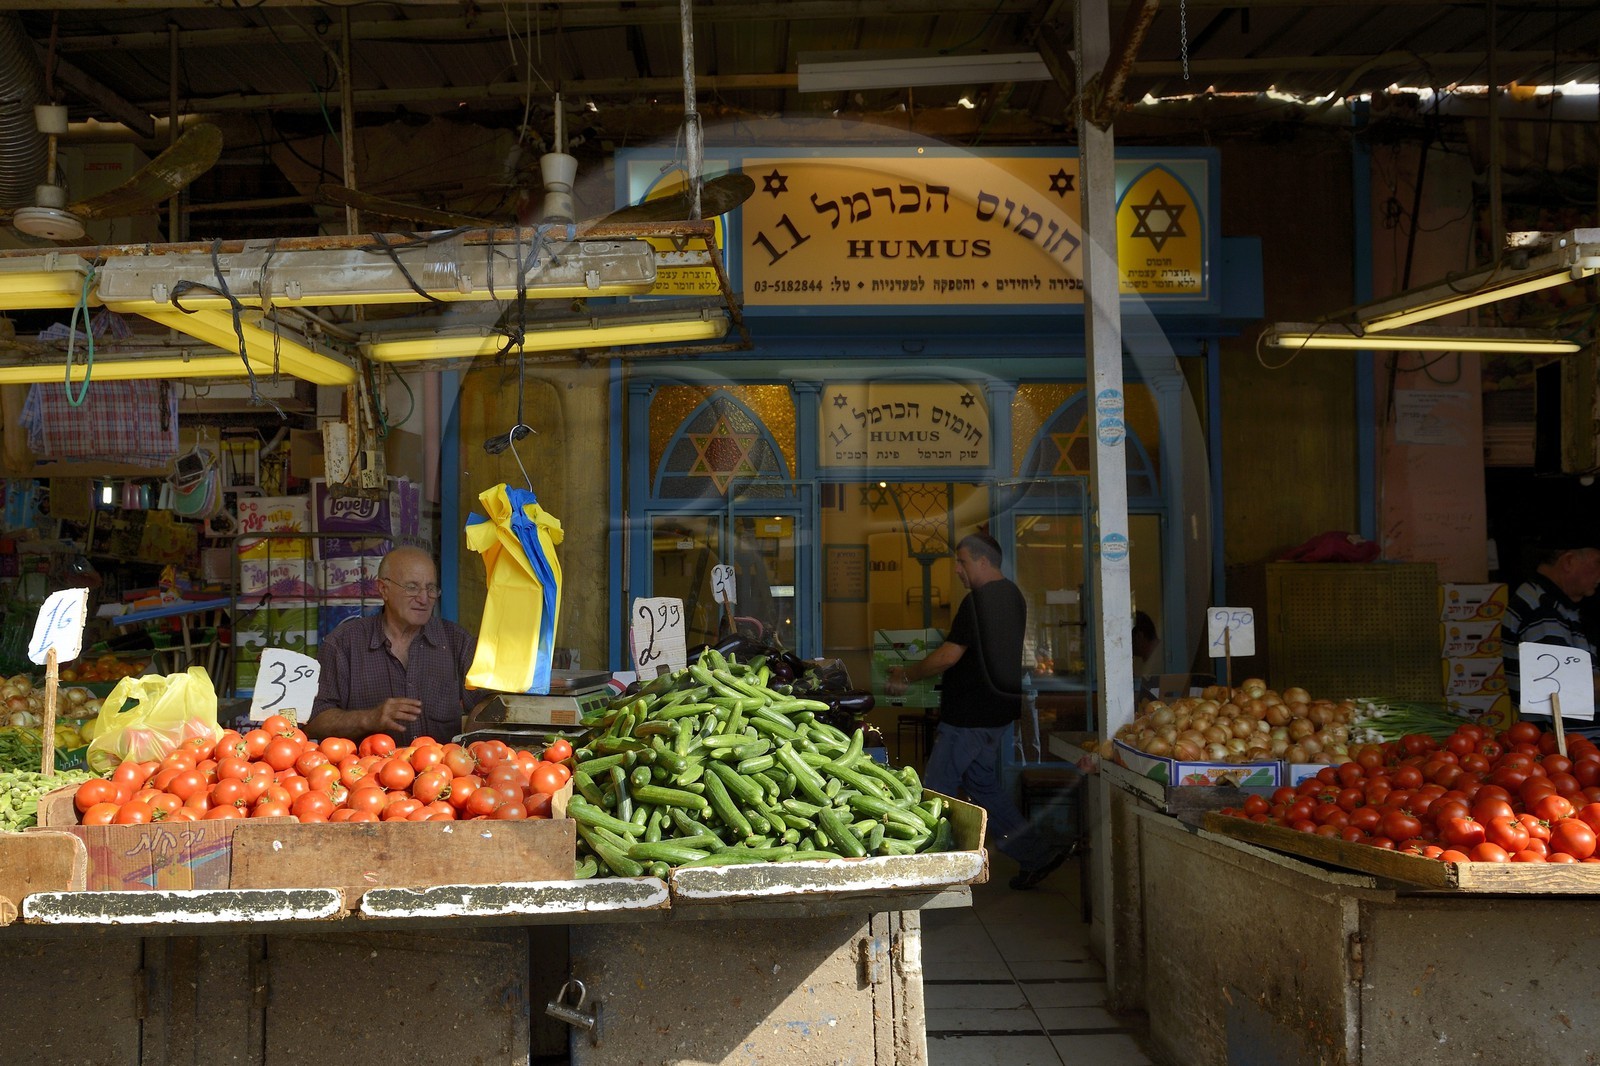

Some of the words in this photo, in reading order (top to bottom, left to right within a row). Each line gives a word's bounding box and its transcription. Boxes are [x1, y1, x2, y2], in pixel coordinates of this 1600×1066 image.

[811, 183, 949, 229] הכרמל
[977, 190, 1081, 262] חומוס
[753, 213, 811, 266] 11
[847, 239, 991, 258] HUMUS
[656, 271, 678, 280] עצמי
[682, 271, 711, 279] תוצרת
[1128, 269, 1156, 279] עצמית
[1161, 269, 1190, 277] תוצרת
[674, 281, 695, 290] חומר
[698, 280, 717, 290] ללא
[754, 280, 823, 292] 03-5182844
[831, 276, 850, 291] טל:
[872, 275, 925, 291] למעדניות
[933, 278, 975, 294] והספקה
[996, 275, 1041, 290] ליחידים
[1152, 279, 1173, 288] חומר
[1177, 278, 1196, 288] ללא
[852, 402, 919, 428] הכרמל
[931, 405, 983, 447] חומוס
[828, 423, 852, 447] 11
[870, 431, 940, 442] HUMUS
[876, 450, 900, 459] פינת
[918, 448, 952, 459] הכרמל
[960, 450, 979, 461] שוק
